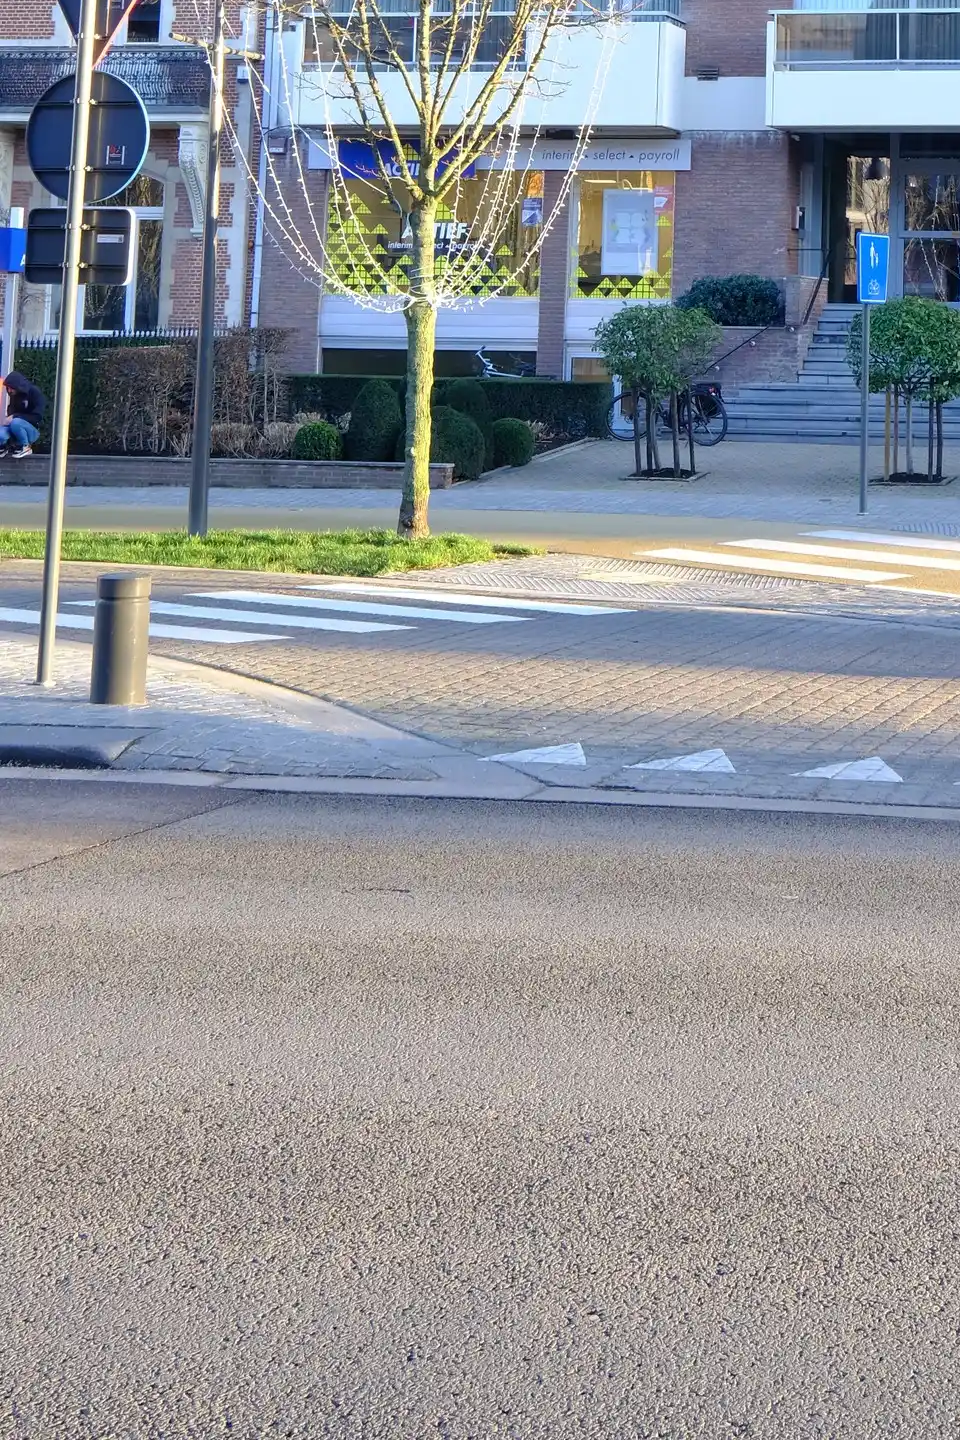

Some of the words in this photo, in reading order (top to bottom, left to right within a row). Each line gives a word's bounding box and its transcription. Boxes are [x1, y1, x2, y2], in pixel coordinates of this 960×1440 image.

[593, 148, 626, 160] select
[639, 149, 680, 163] payroll
[401, 222, 468, 239] ATIEF
